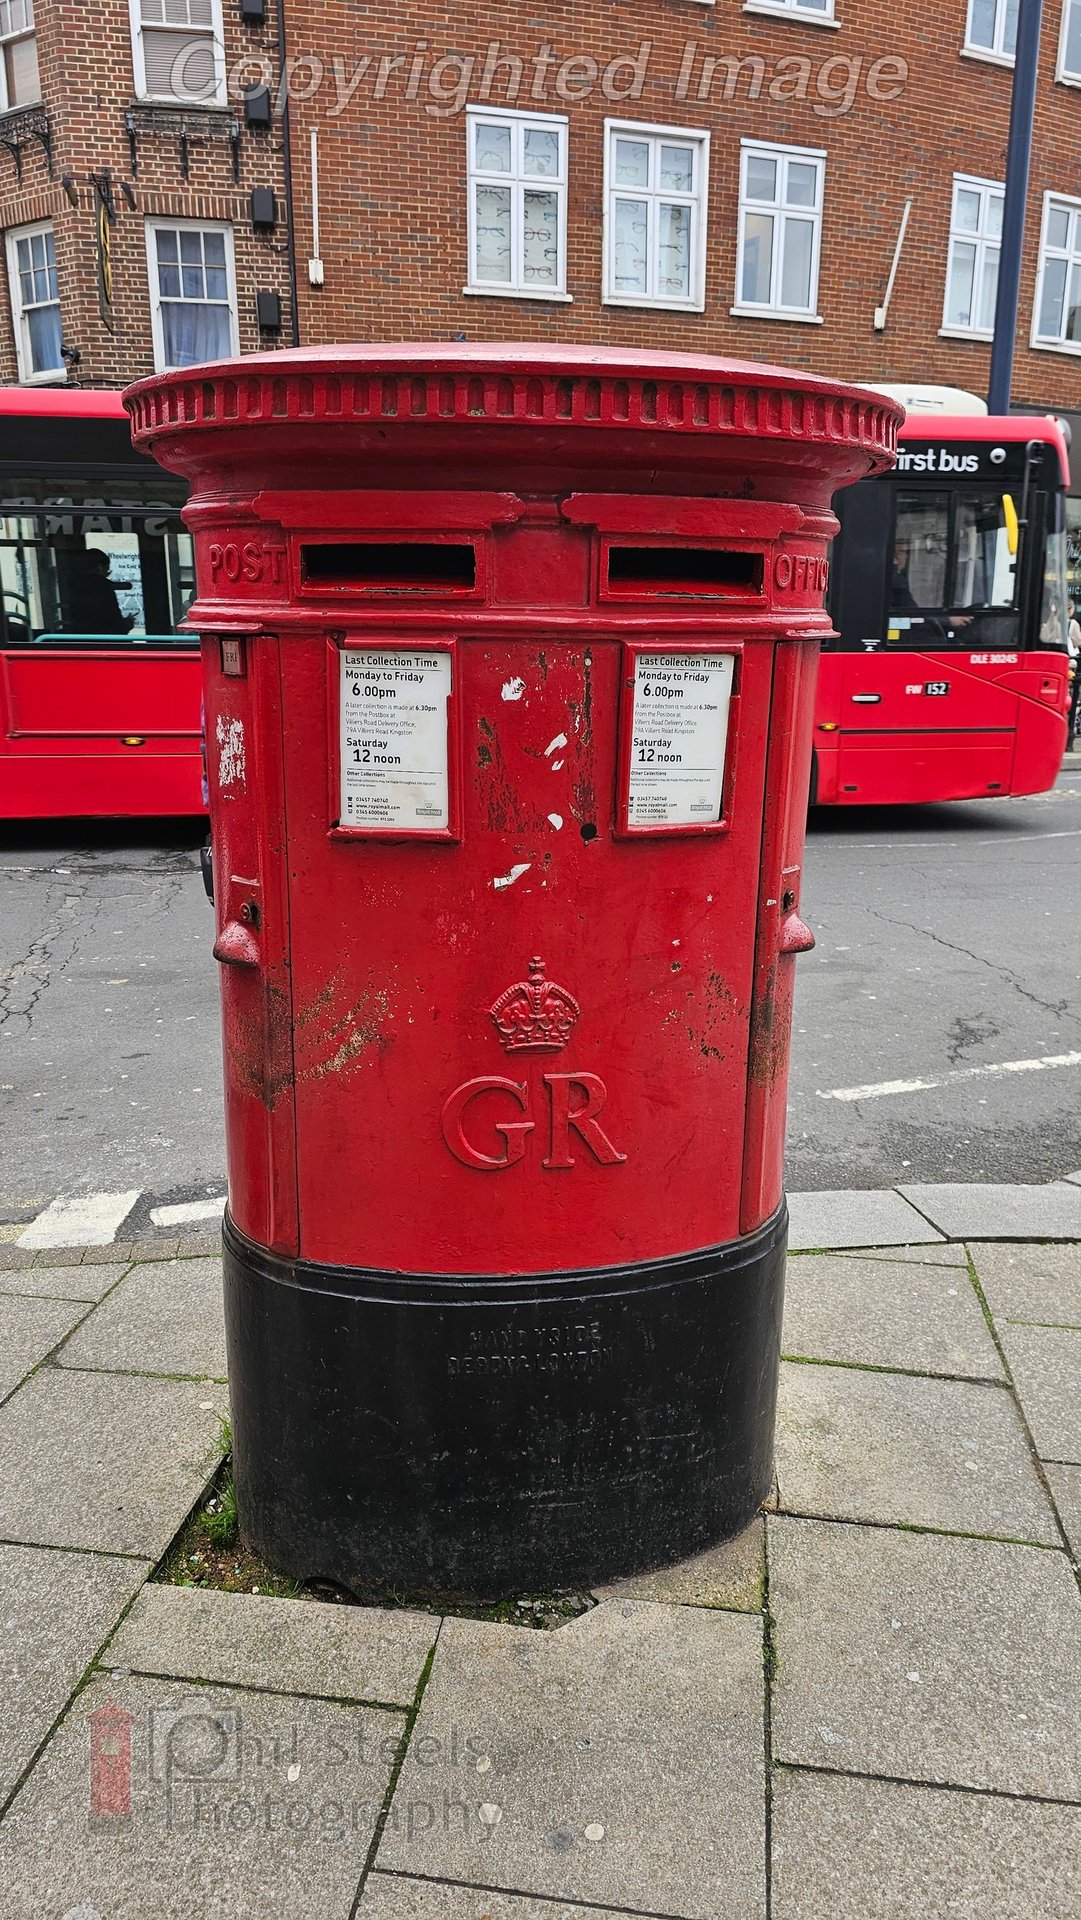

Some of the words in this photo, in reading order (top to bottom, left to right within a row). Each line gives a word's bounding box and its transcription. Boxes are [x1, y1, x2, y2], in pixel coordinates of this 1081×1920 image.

[938, 448, 979, 472] bus
[209, 542, 287, 583] POST
[225, 652, 238, 662] FRI
[346, 655, 365, 665] Last
[367, 656, 412, 666] Collection
[414, 658, 438, 667] Time
[640, 656, 658, 666] Last
[660, 657, 700, 667] Collection
[703, 659, 722, 668] Time
[970, 654, 988, 664] DLE
[346, 670, 381, 681] Monday
[395, 672, 424, 683] Friday
[639, 671, 671, 682] Monday
[684, 673, 709, 683] Friday
[352, 683, 396, 699] 6.00pm
[643, 683, 683, 699] 6.00pm
[905, 685, 923, 695] FW
[927, 682, 947, 695] 152
[378, 720, 398, 728] Delivery
[347, 738, 388, 749] Saturday
[633, 738, 671, 748] Saturday
[353, 749, 371, 762] 12
[374, 755, 400, 764] noon
[638, 749, 655, 761] 12
[442, 1071, 628, 1171] GR
